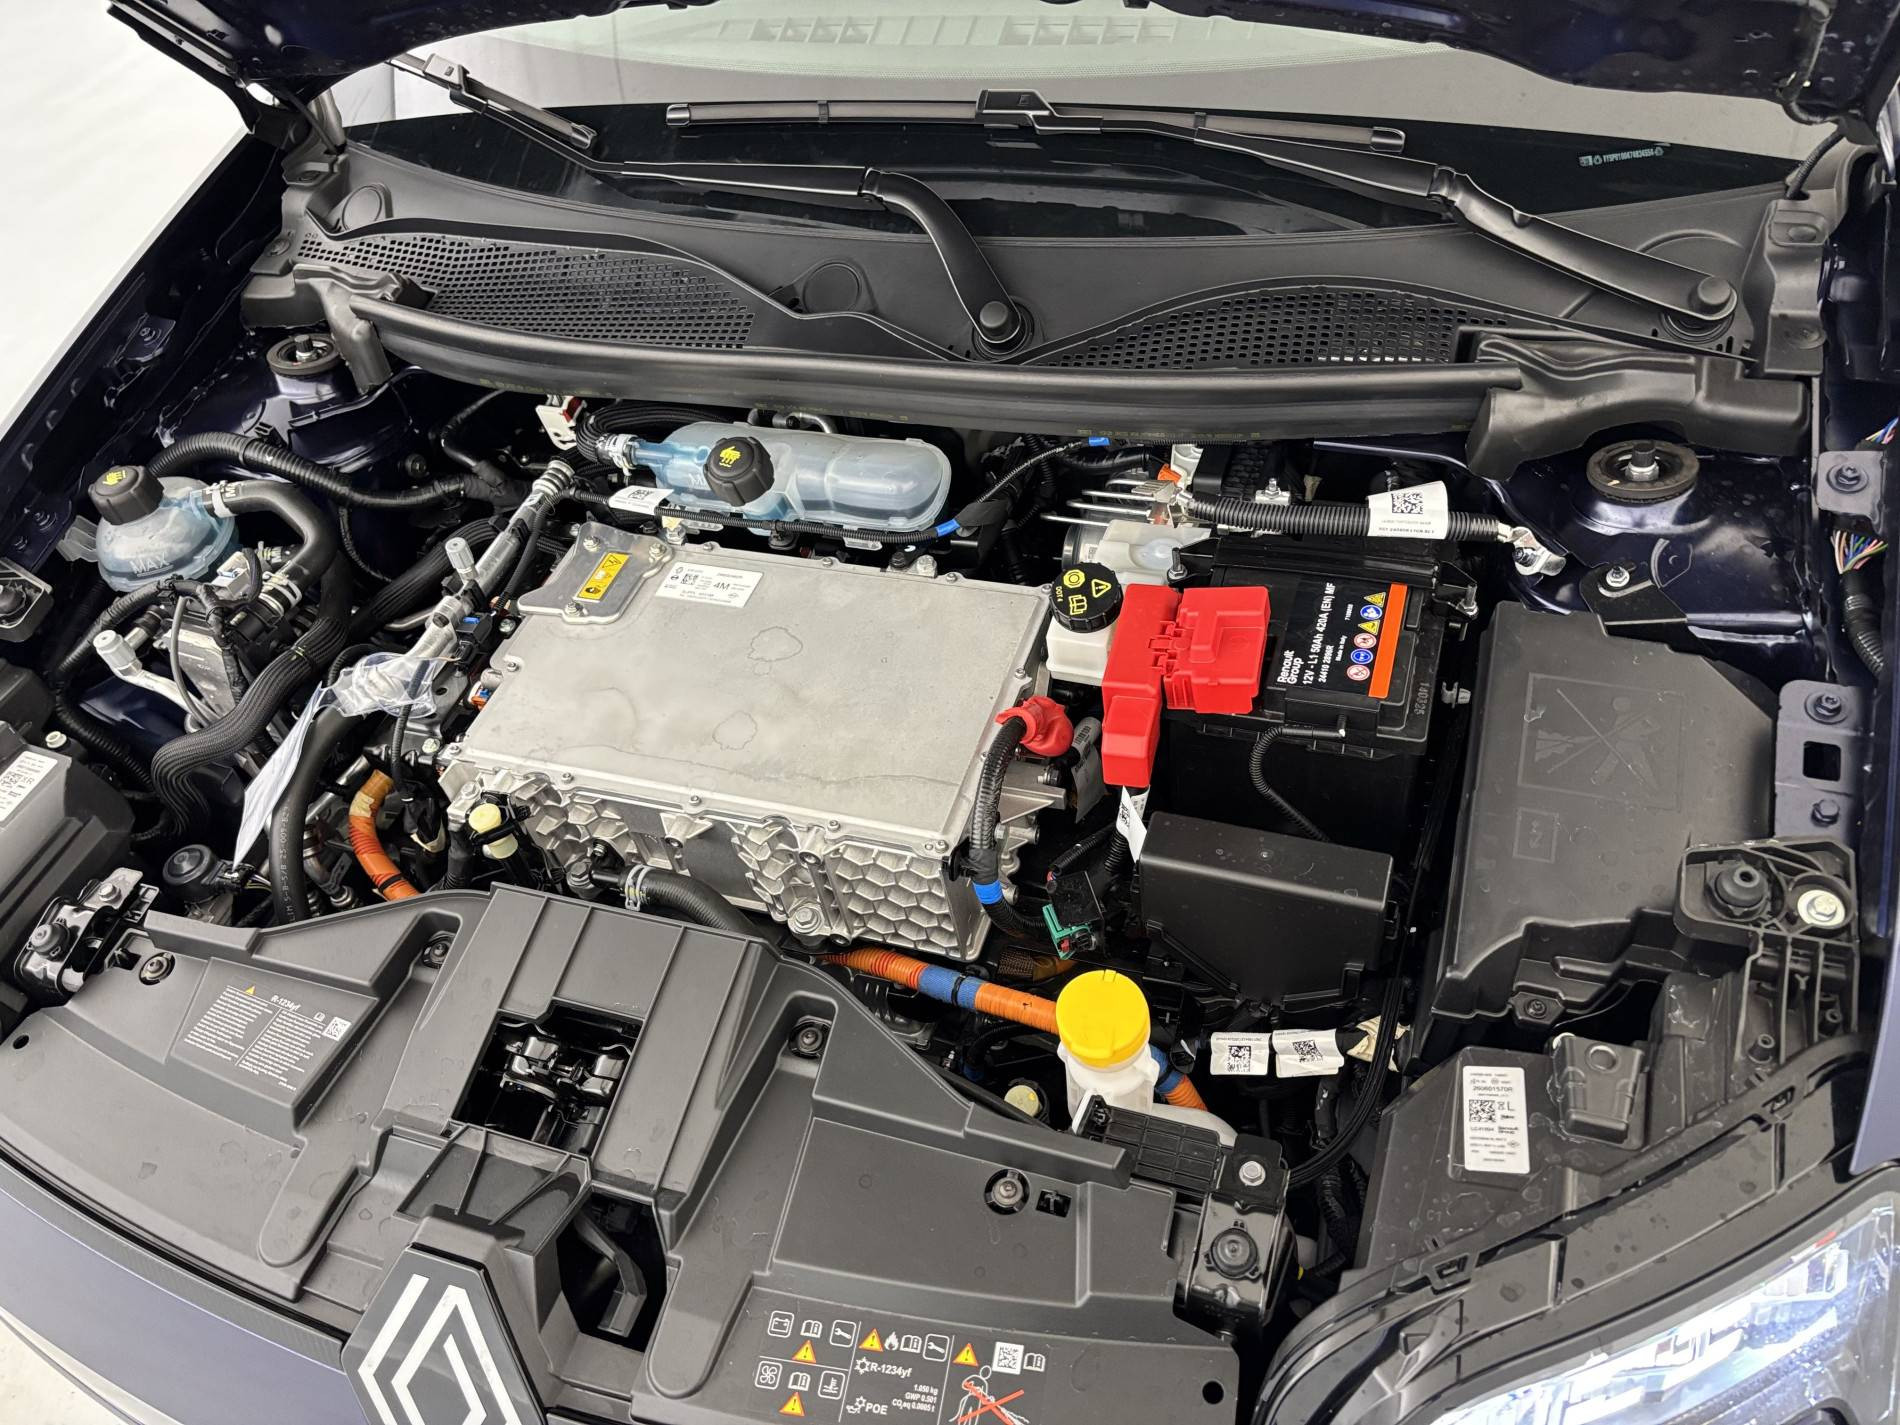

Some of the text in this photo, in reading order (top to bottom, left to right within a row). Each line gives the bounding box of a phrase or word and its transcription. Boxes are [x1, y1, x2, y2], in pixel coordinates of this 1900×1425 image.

[129, 553, 173, 576] MAX
[1324, 582, 1336, 595] MF
[1320, 595, 1336, 612] (EN)
[1315, 612, 1330, 633] 420A
[1310, 633, 1325, 653] 50Ah
[1307, 654, 1319, 664] L1
[1335, 649, 1343, 661] Made
[1277, 650, 1295, 683] Renault
[1286, 657, 1304, 684] Group
[1302, 669, 1315, 685] 12V
[270, 995, 301, 1012] R-1234yf
[870, 1362, 913, 1378] R-1234yf
[905, 1392, 920, 1401] GWP
[914, 1384, 938, 1395] 1.050 kg
[865, 1402, 888, 1415] POE
